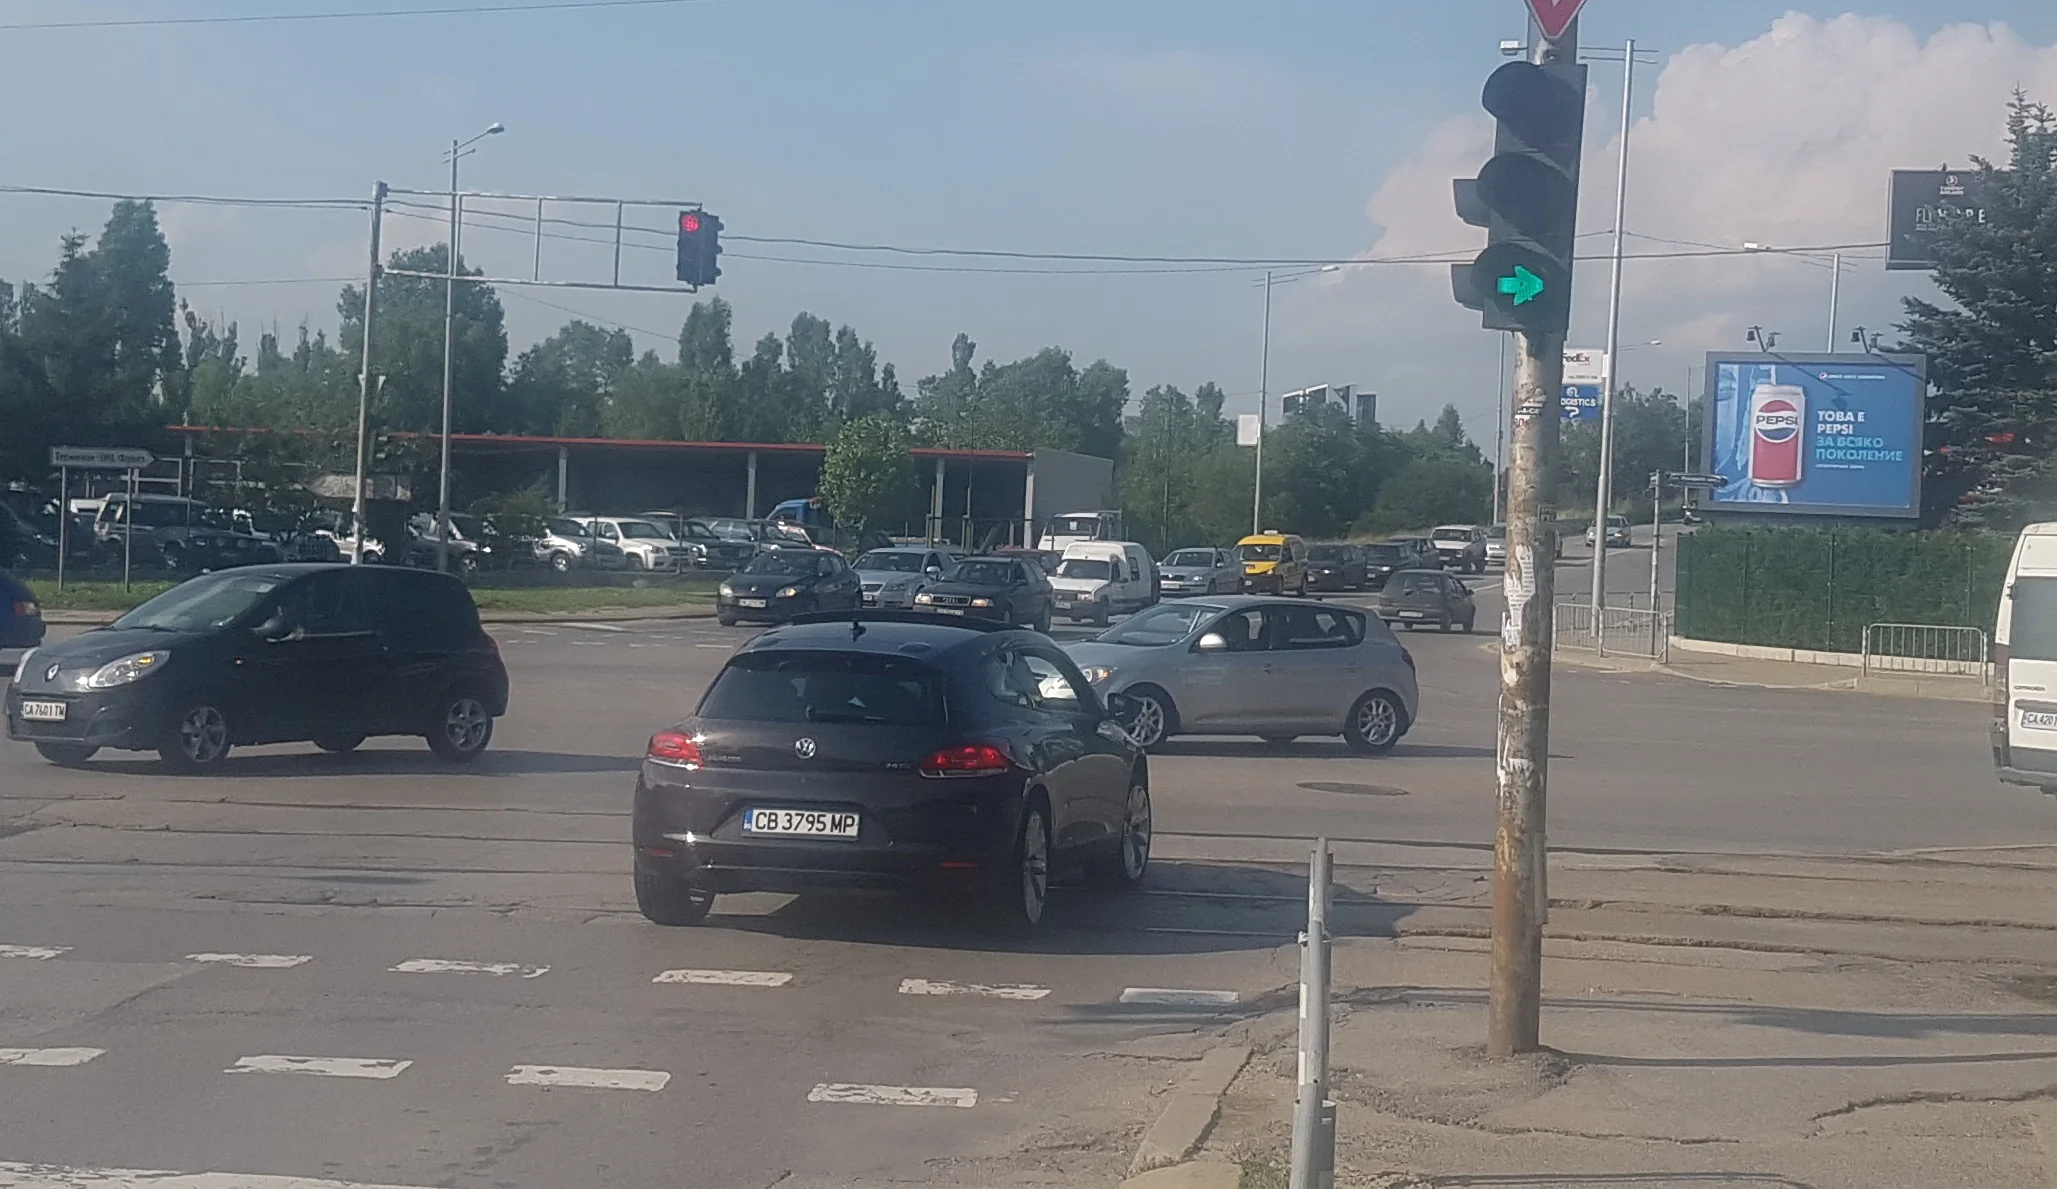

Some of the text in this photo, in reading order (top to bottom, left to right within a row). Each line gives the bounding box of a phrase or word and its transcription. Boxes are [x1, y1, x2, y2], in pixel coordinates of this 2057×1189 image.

[1561, 398, 1596, 407] OGISTICS
[1756, 415, 1799, 426] PEPSI
[1817, 411, 1866, 422] ТОВА Е
[1817, 424, 1854, 435] PEPSI
[1816, 436, 1884, 448] ЗА ВСЯКО
[1815, 449, 1903, 461] ПОКОЛЕНИЕ
[755, 812, 856, 833] CB 3795 MP
